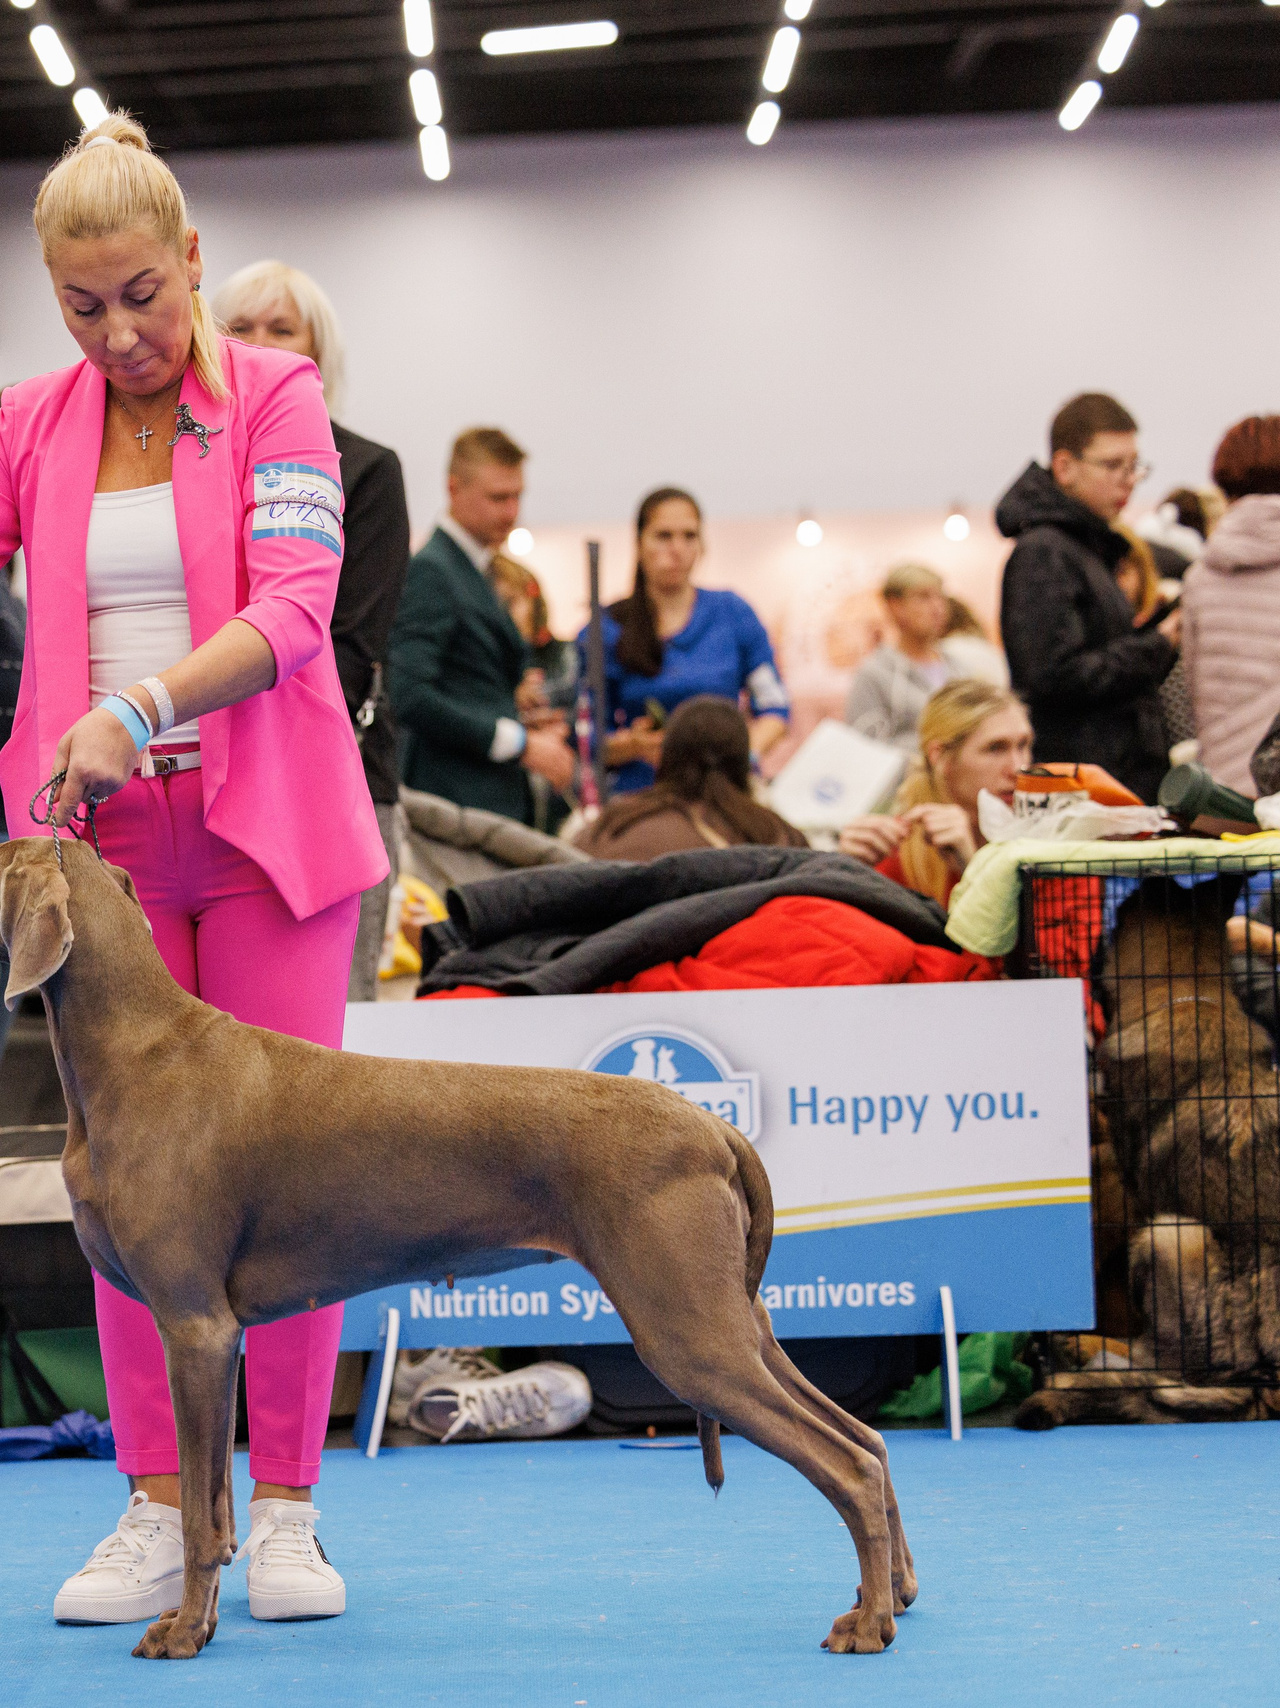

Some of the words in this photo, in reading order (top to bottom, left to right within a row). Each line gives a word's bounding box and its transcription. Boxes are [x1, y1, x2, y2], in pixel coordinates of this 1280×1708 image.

[789, 1086, 929, 1135] Happy
[946, 1091, 1039, 1133] you.
[410, 1284, 549, 1319] Nutrition
[560, 1283, 616, 1322] Sys
[762, 1275, 916, 1309] arnivores
